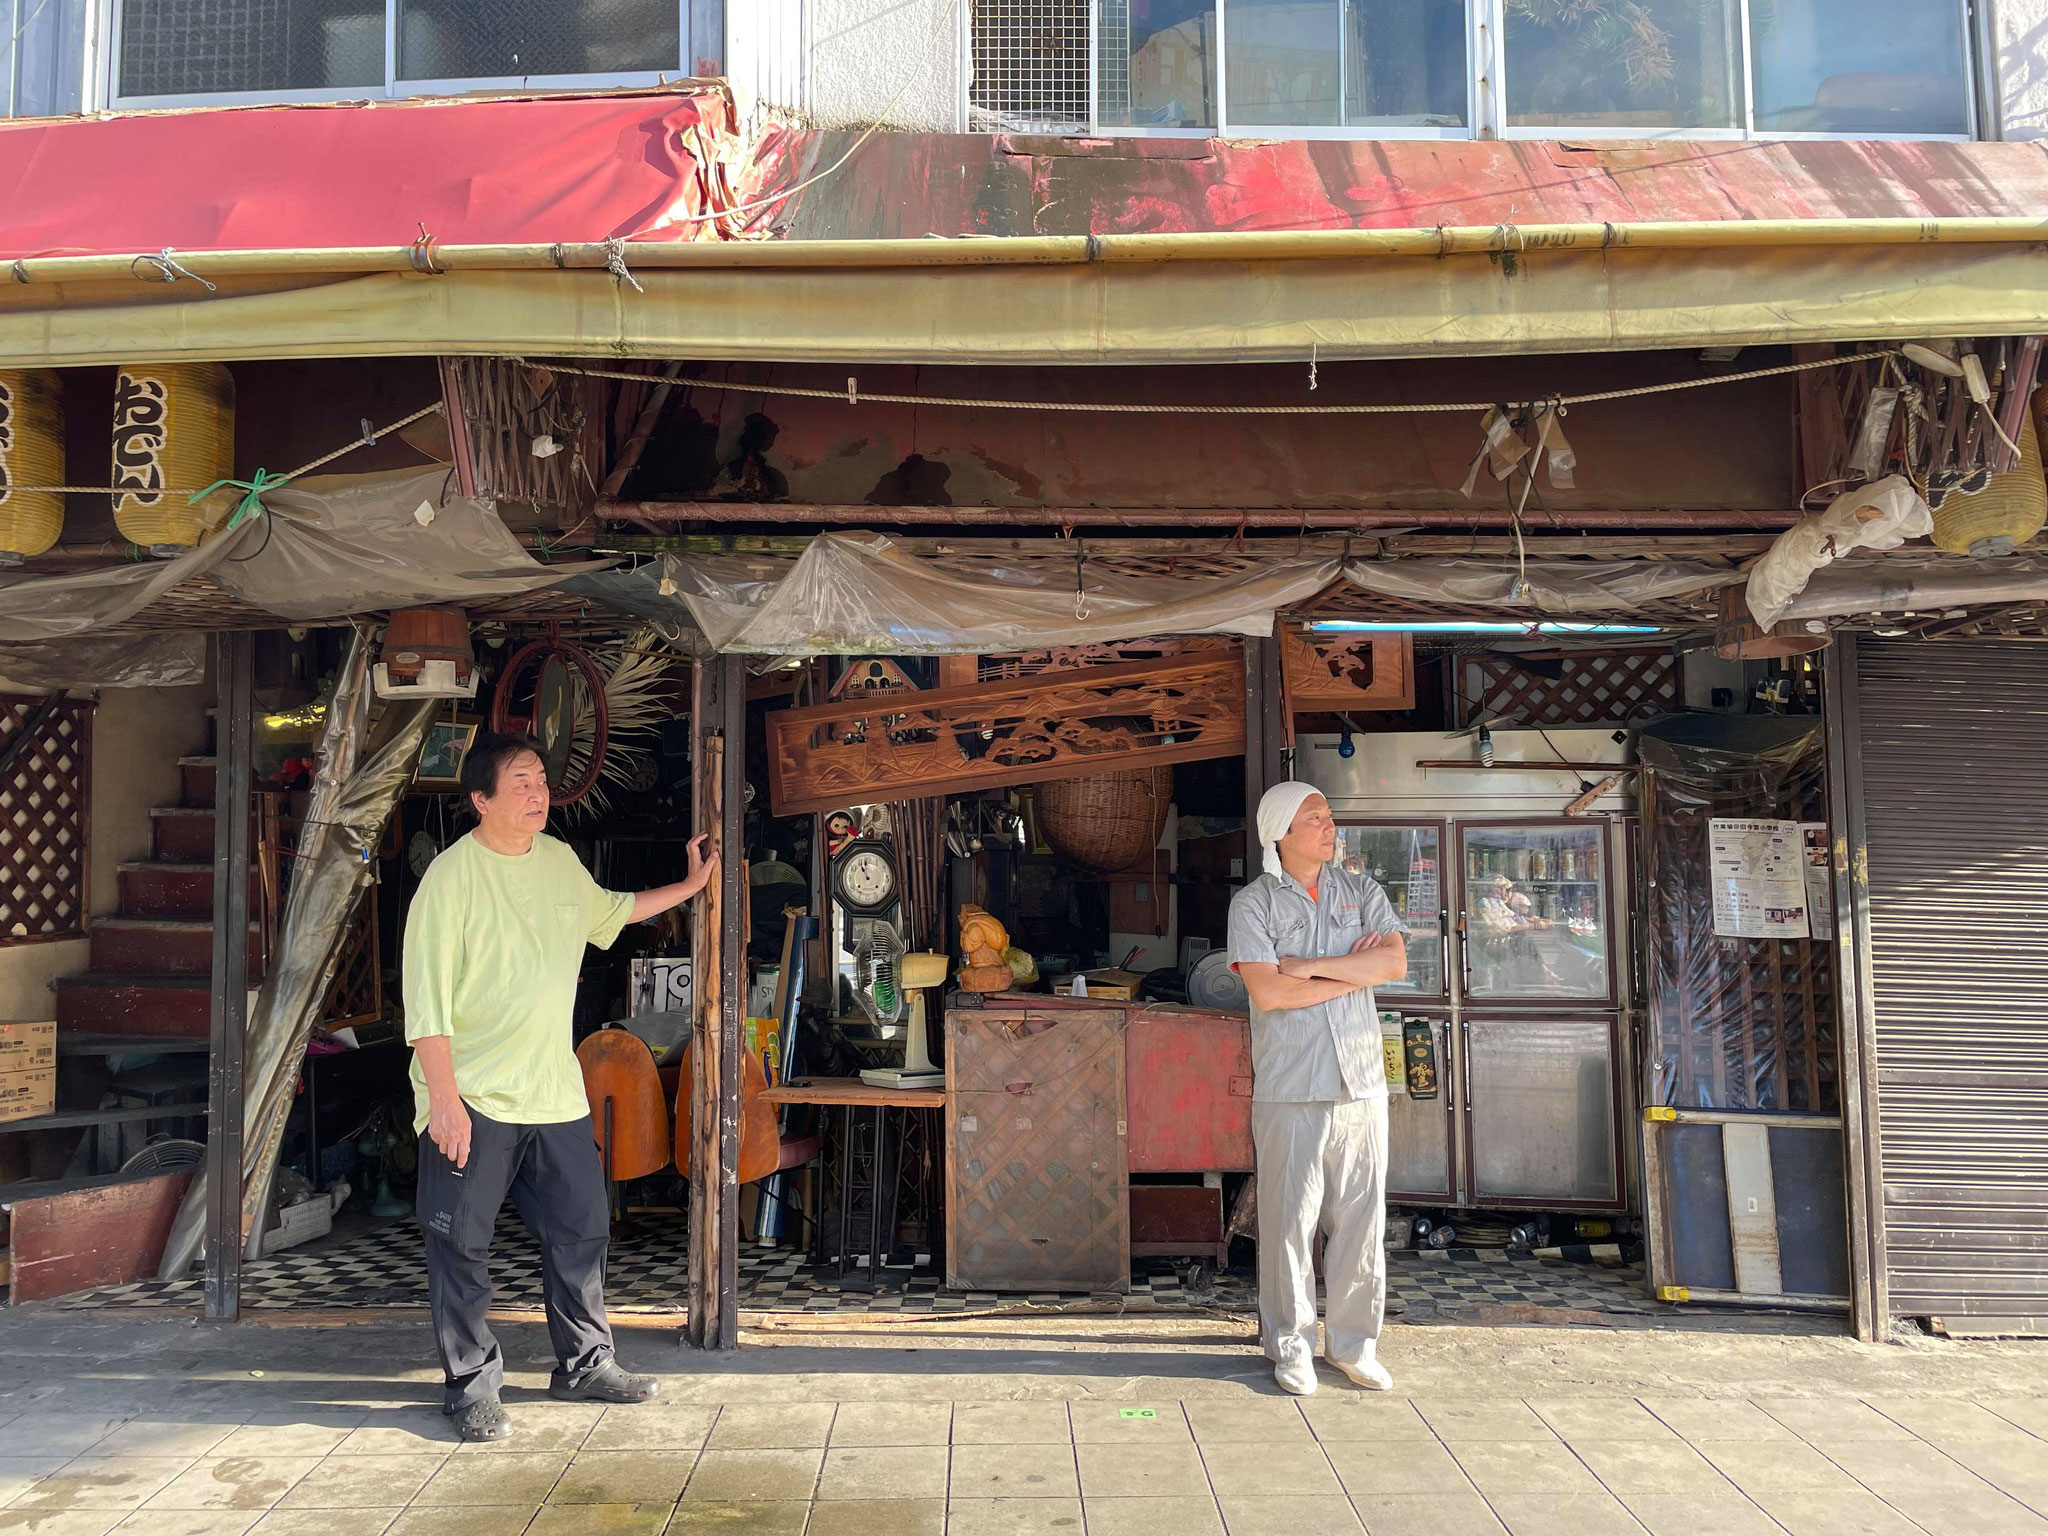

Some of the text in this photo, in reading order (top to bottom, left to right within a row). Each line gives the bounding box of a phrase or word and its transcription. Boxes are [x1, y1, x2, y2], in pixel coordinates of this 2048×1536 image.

[113, 374, 166, 510] おでん
[1385, 1049, 1396, 1079] いいちこ
